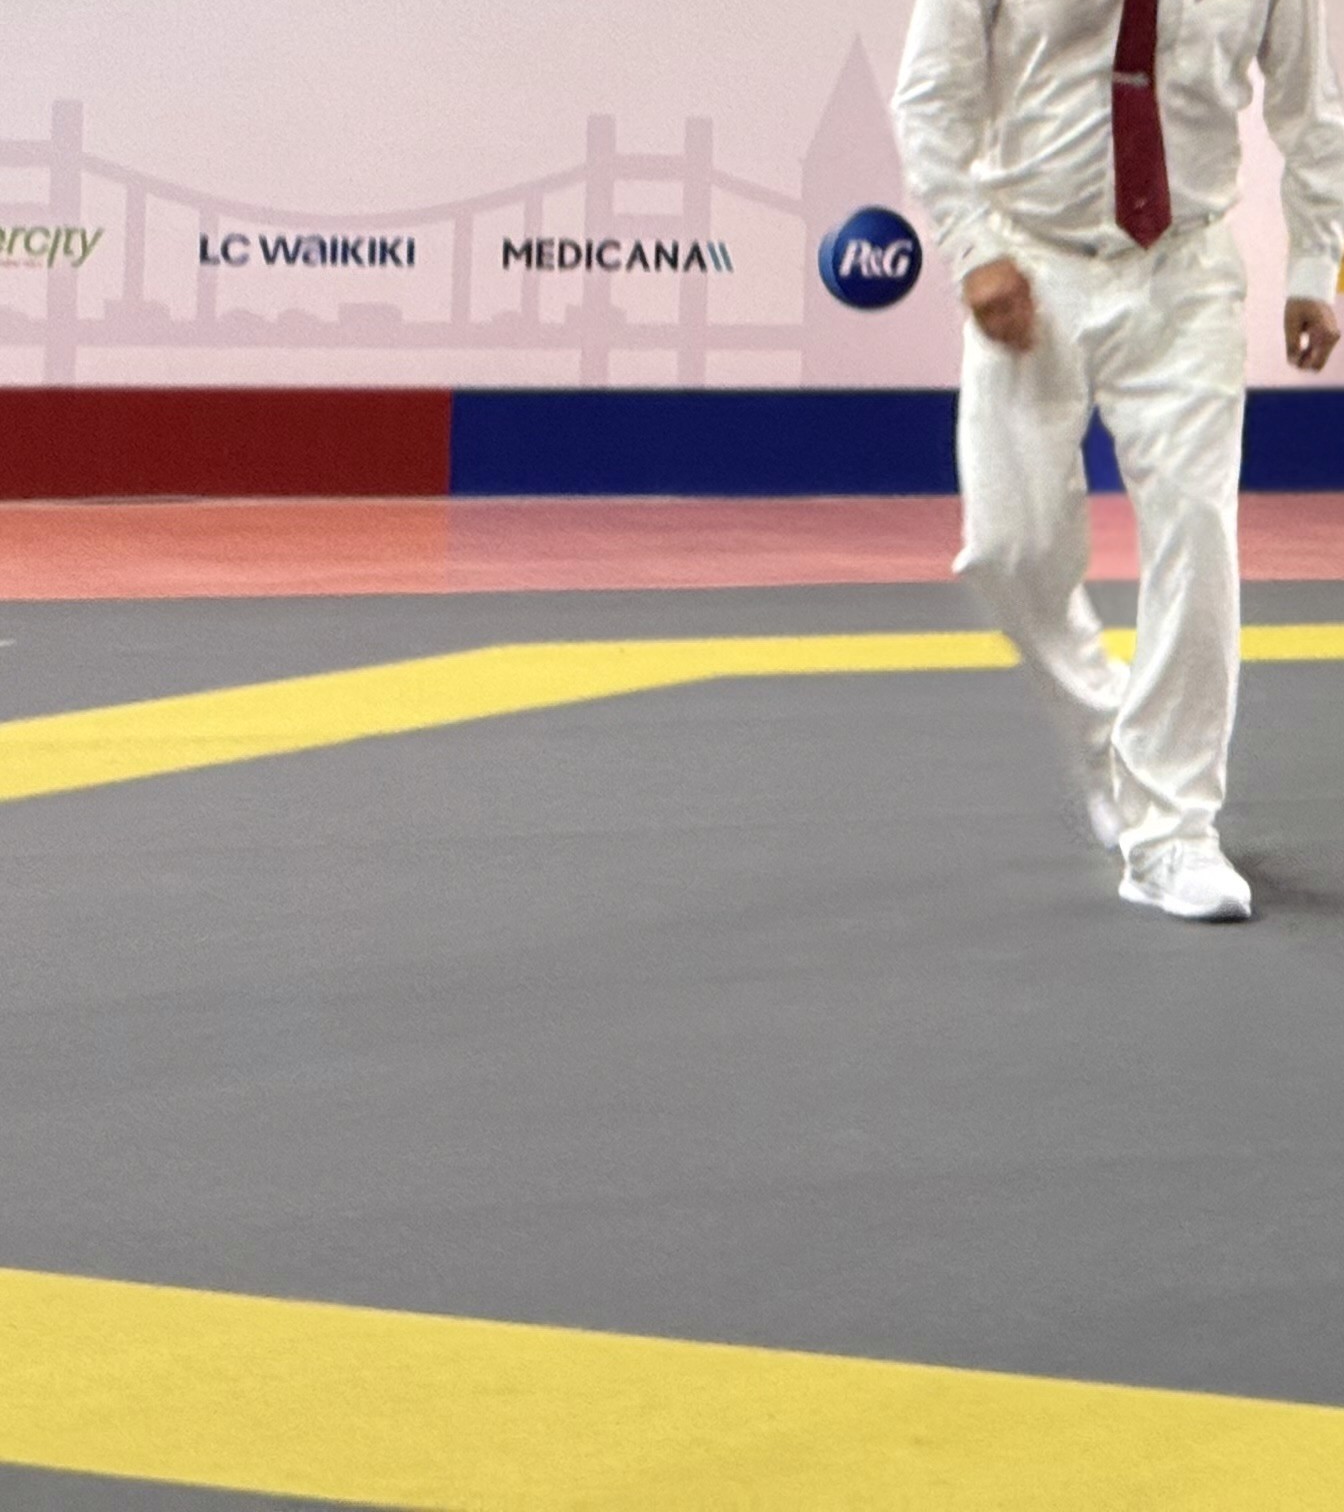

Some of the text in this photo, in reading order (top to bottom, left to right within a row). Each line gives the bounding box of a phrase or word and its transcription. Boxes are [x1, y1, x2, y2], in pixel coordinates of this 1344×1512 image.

[200, 232, 250, 267] LC
[502, 237, 708, 273] MEDICANA
[838, 238, 915, 280] P&G
